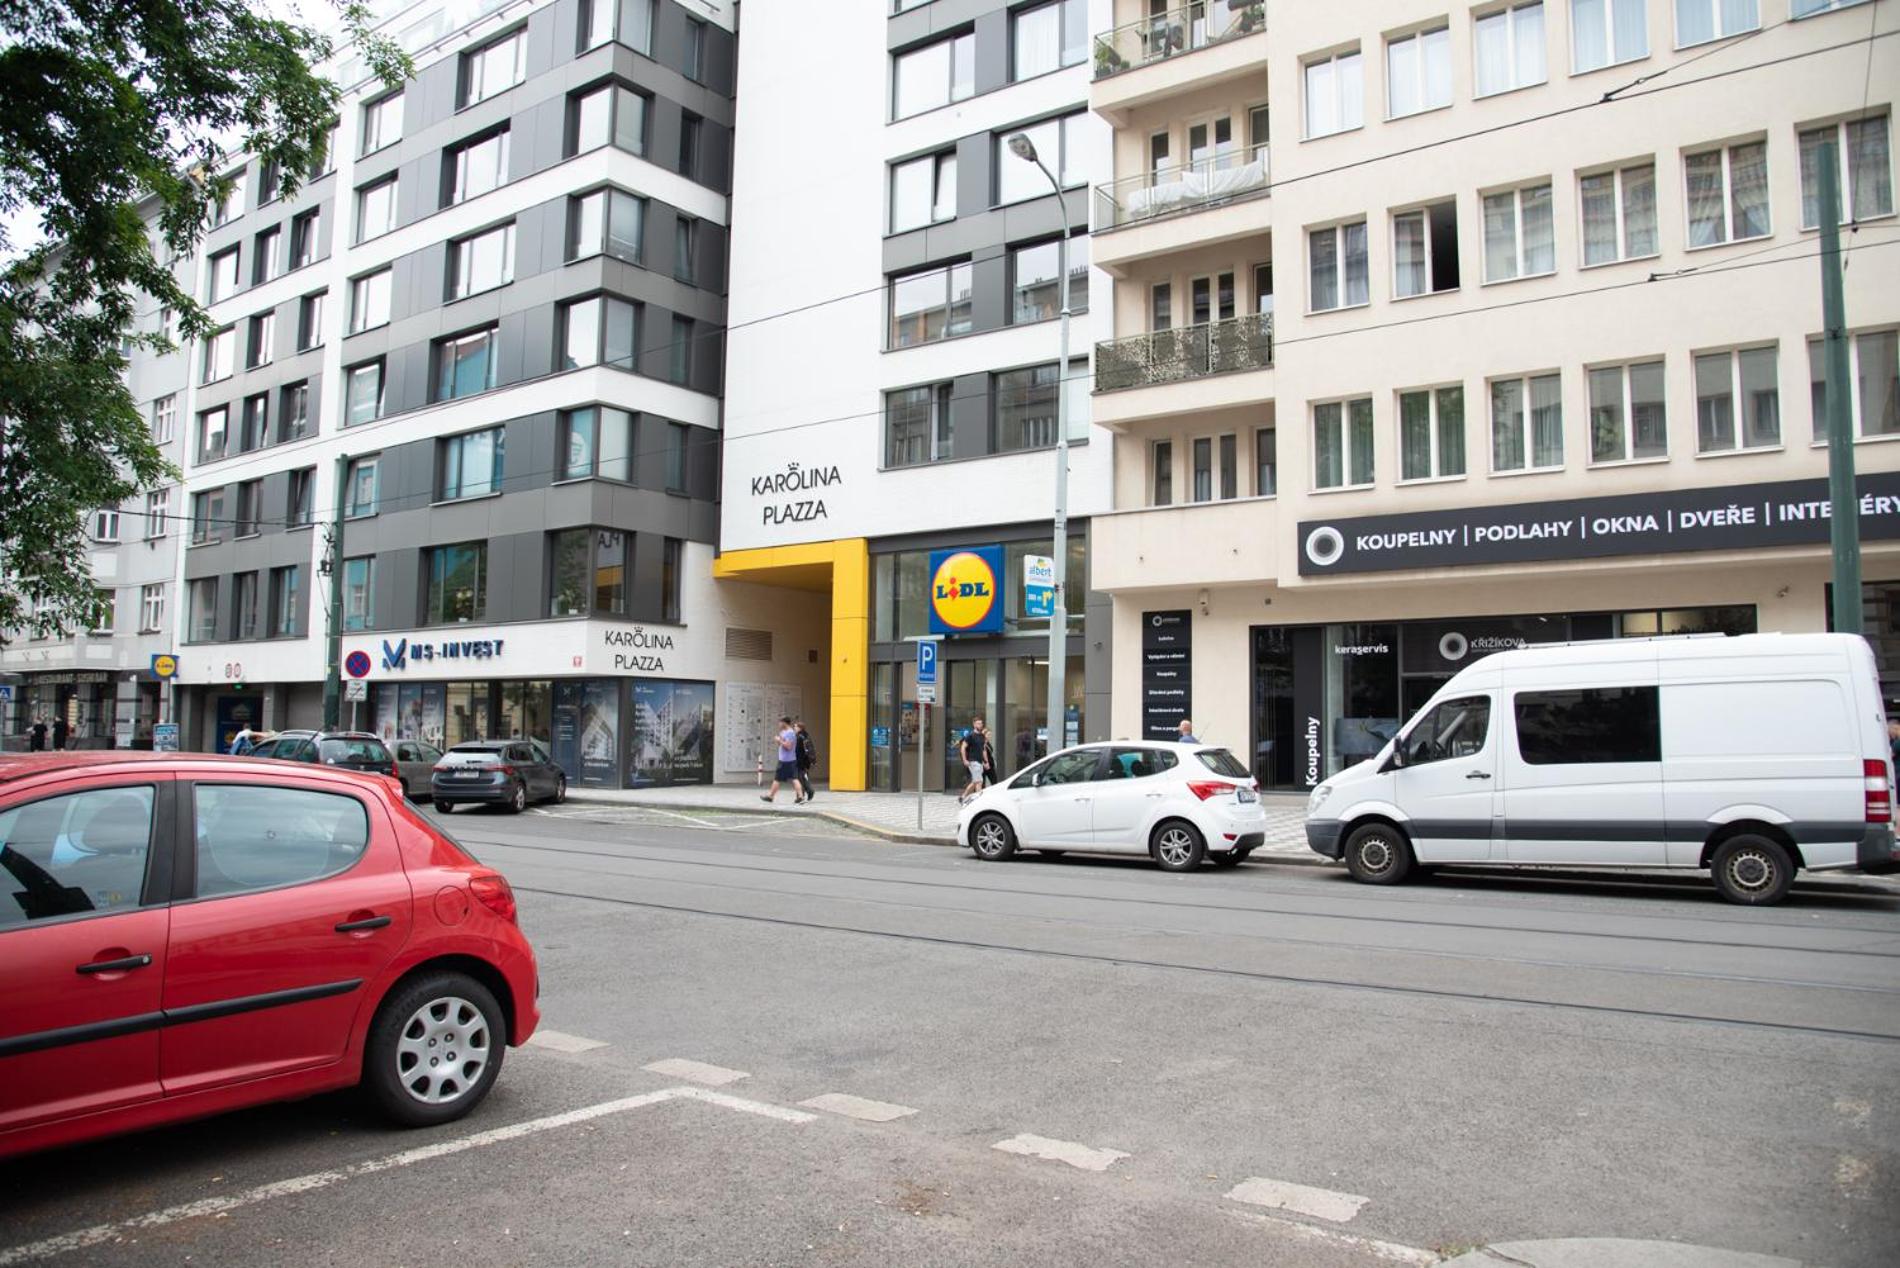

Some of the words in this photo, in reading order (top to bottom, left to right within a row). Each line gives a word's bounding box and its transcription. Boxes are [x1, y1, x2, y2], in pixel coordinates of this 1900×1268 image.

[752, 463, 842, 496] KAROLINA
[763, 499, 827, 525] PLAZZA
[1356, 528, 1457, 551] KOUPELNY
[1474, 520, 1573, 542] PODLAHY
[1592, 514, 1660, 535] OKNA
[1680, 504, 1756, 529] DVEŘE
[1779, 493, 1900, 521] INTEÉRY
[605, 626, 674, 649] KAROLINA
[1334, 643, 1389, 656] keraservis
[615, 654, 664, 671] PLAZZA
[922, 645, 933, 670] P
[1305, 716, 1320, 786] Koupelny
